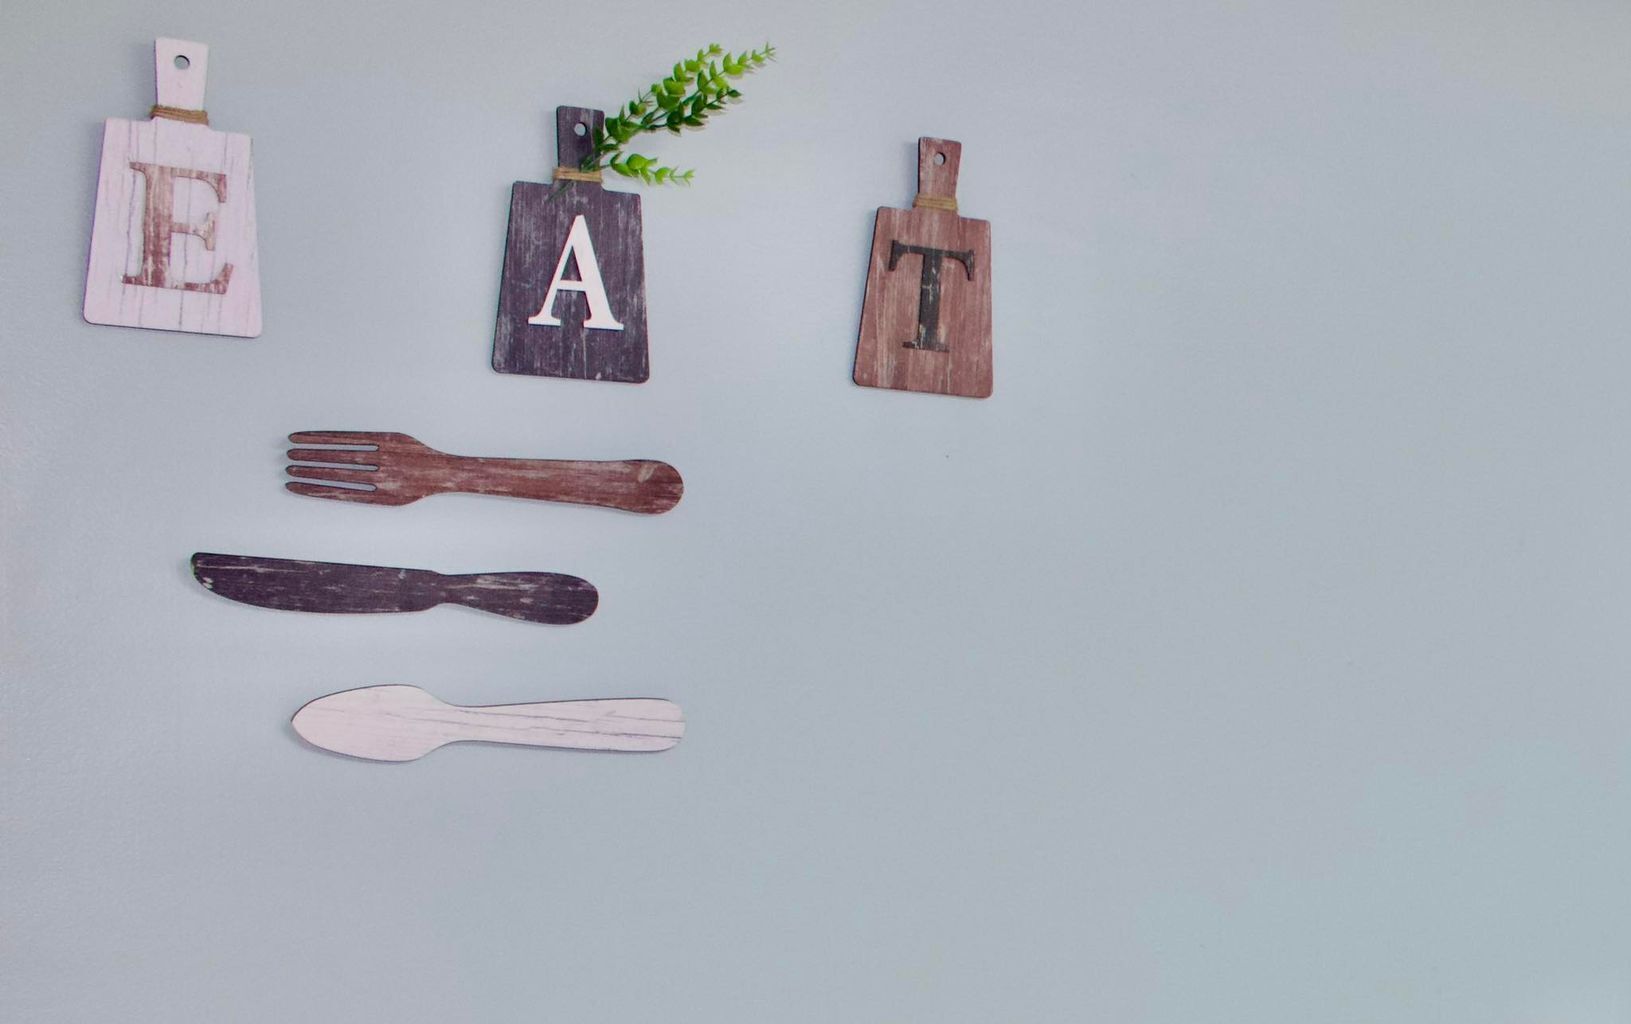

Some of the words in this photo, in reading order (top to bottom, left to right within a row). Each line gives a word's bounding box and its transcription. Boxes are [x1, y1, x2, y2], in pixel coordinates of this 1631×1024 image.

[121, 160, 234, 294] E
[527, 213, 625, 332] A
[888, 239, 976, 353] T
